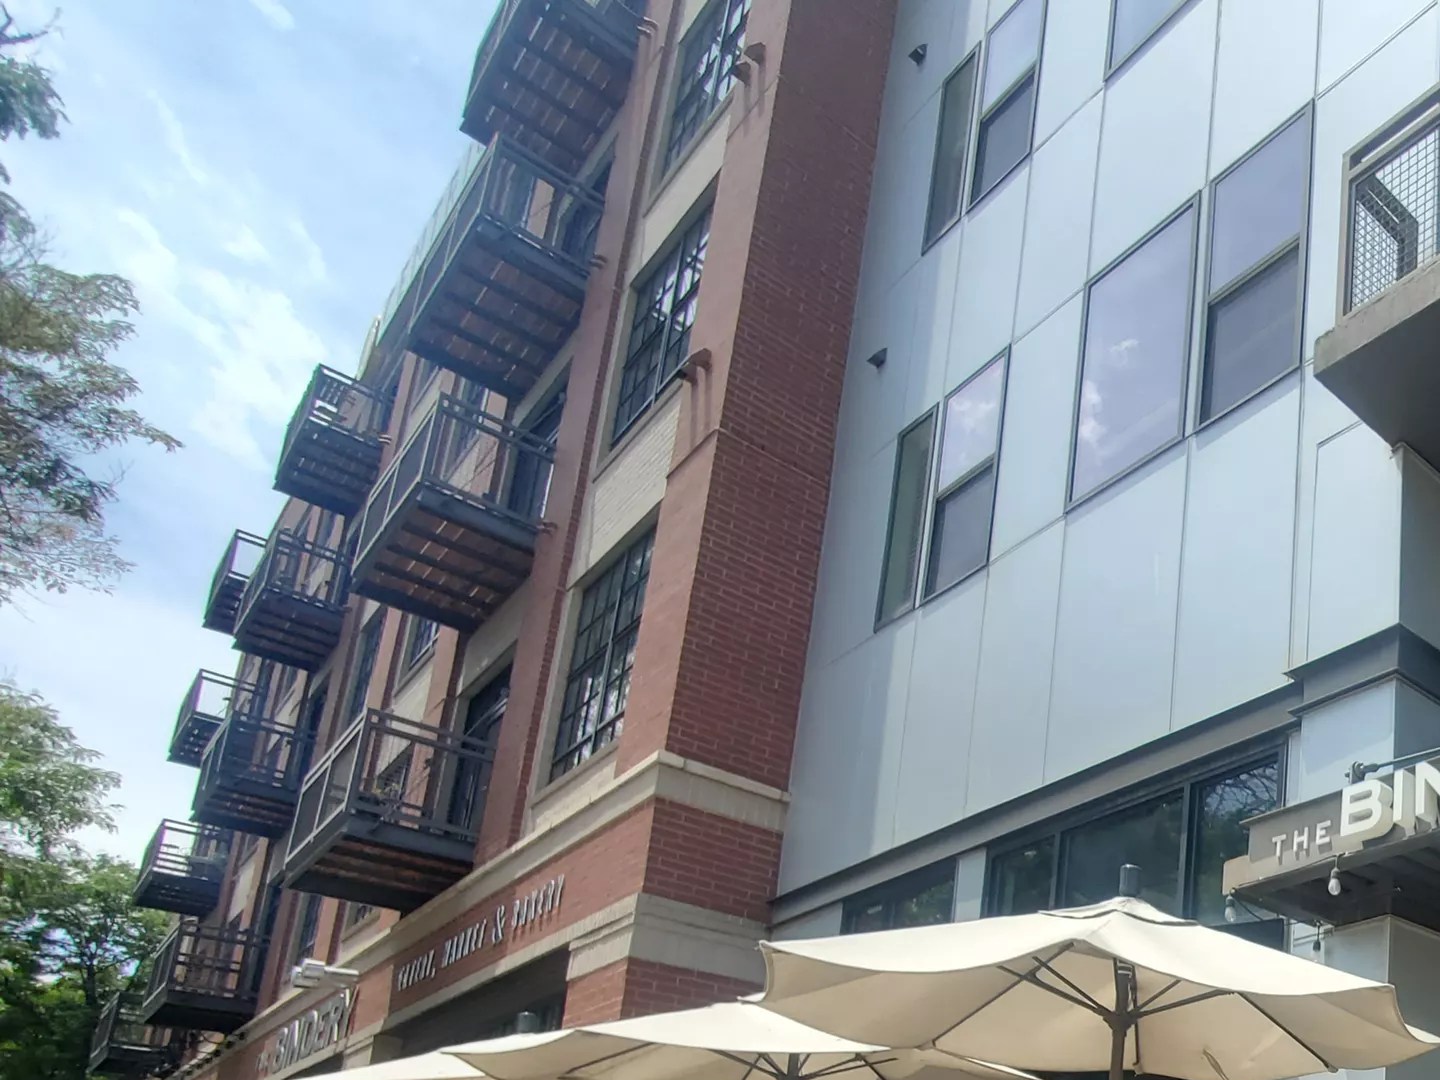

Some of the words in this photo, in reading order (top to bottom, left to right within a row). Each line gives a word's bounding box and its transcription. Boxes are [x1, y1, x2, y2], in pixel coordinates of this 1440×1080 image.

[1271, 819, 1331, 857] THE
[492, 904, 506, 944] &
[272, 984, 359, 1074] BINDERY
